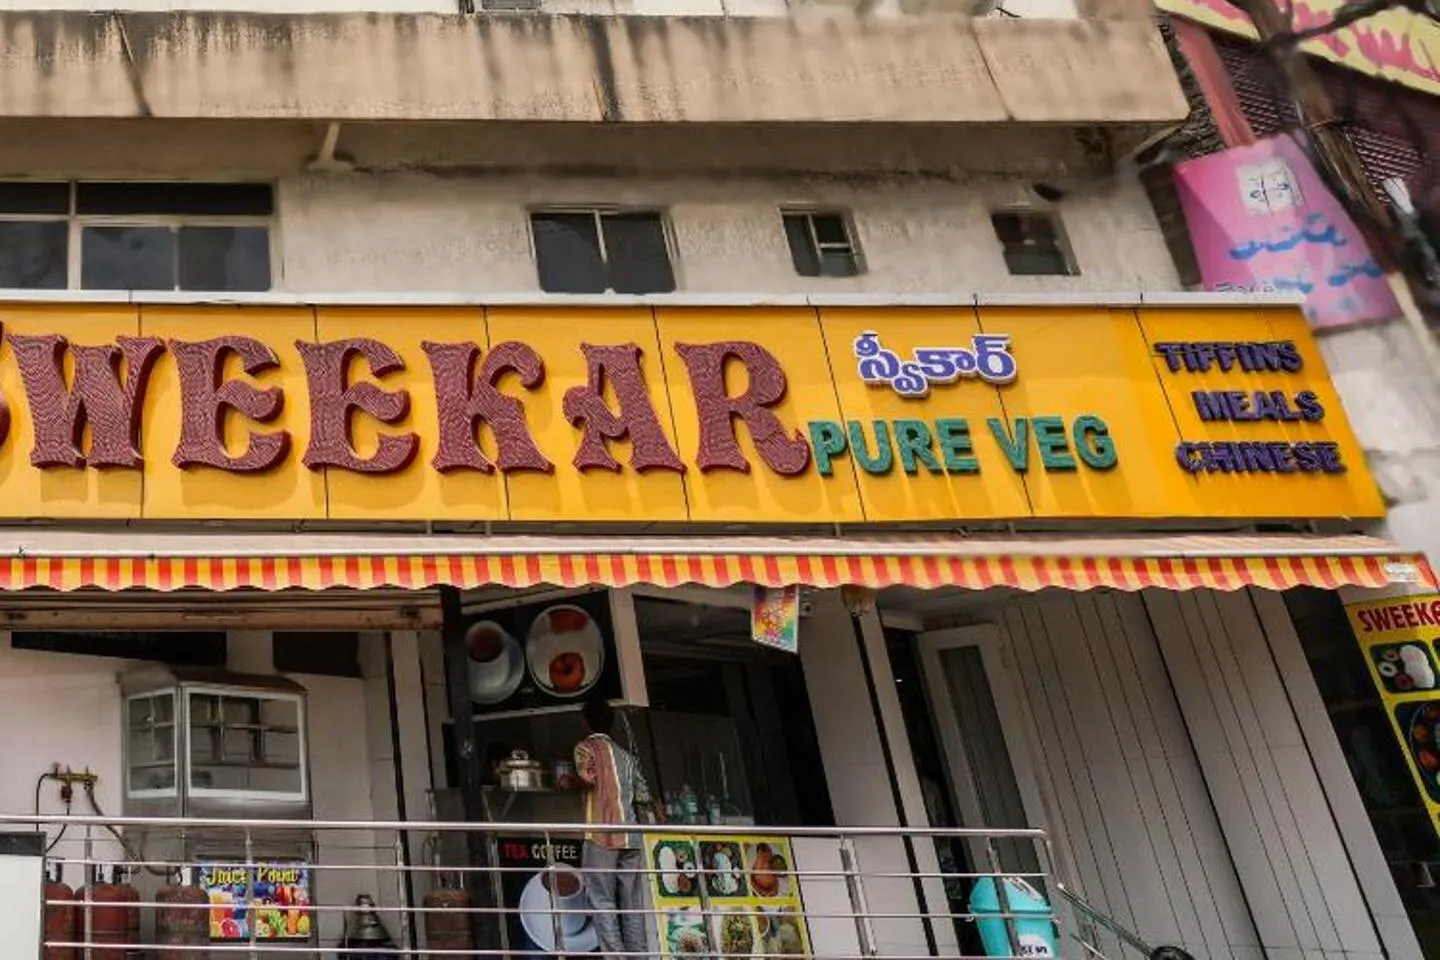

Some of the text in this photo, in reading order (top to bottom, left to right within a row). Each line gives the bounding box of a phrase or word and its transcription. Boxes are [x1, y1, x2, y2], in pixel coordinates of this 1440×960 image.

[1154, 341, 1304, 374] TIFFINS
[1191, 391, 1325, 423] MEALS
[808, 415, 1118, 476] PURE VEG
[1175, 442, 1348, 475] CHINESE
[531, 843, 578, 860] COFEE
